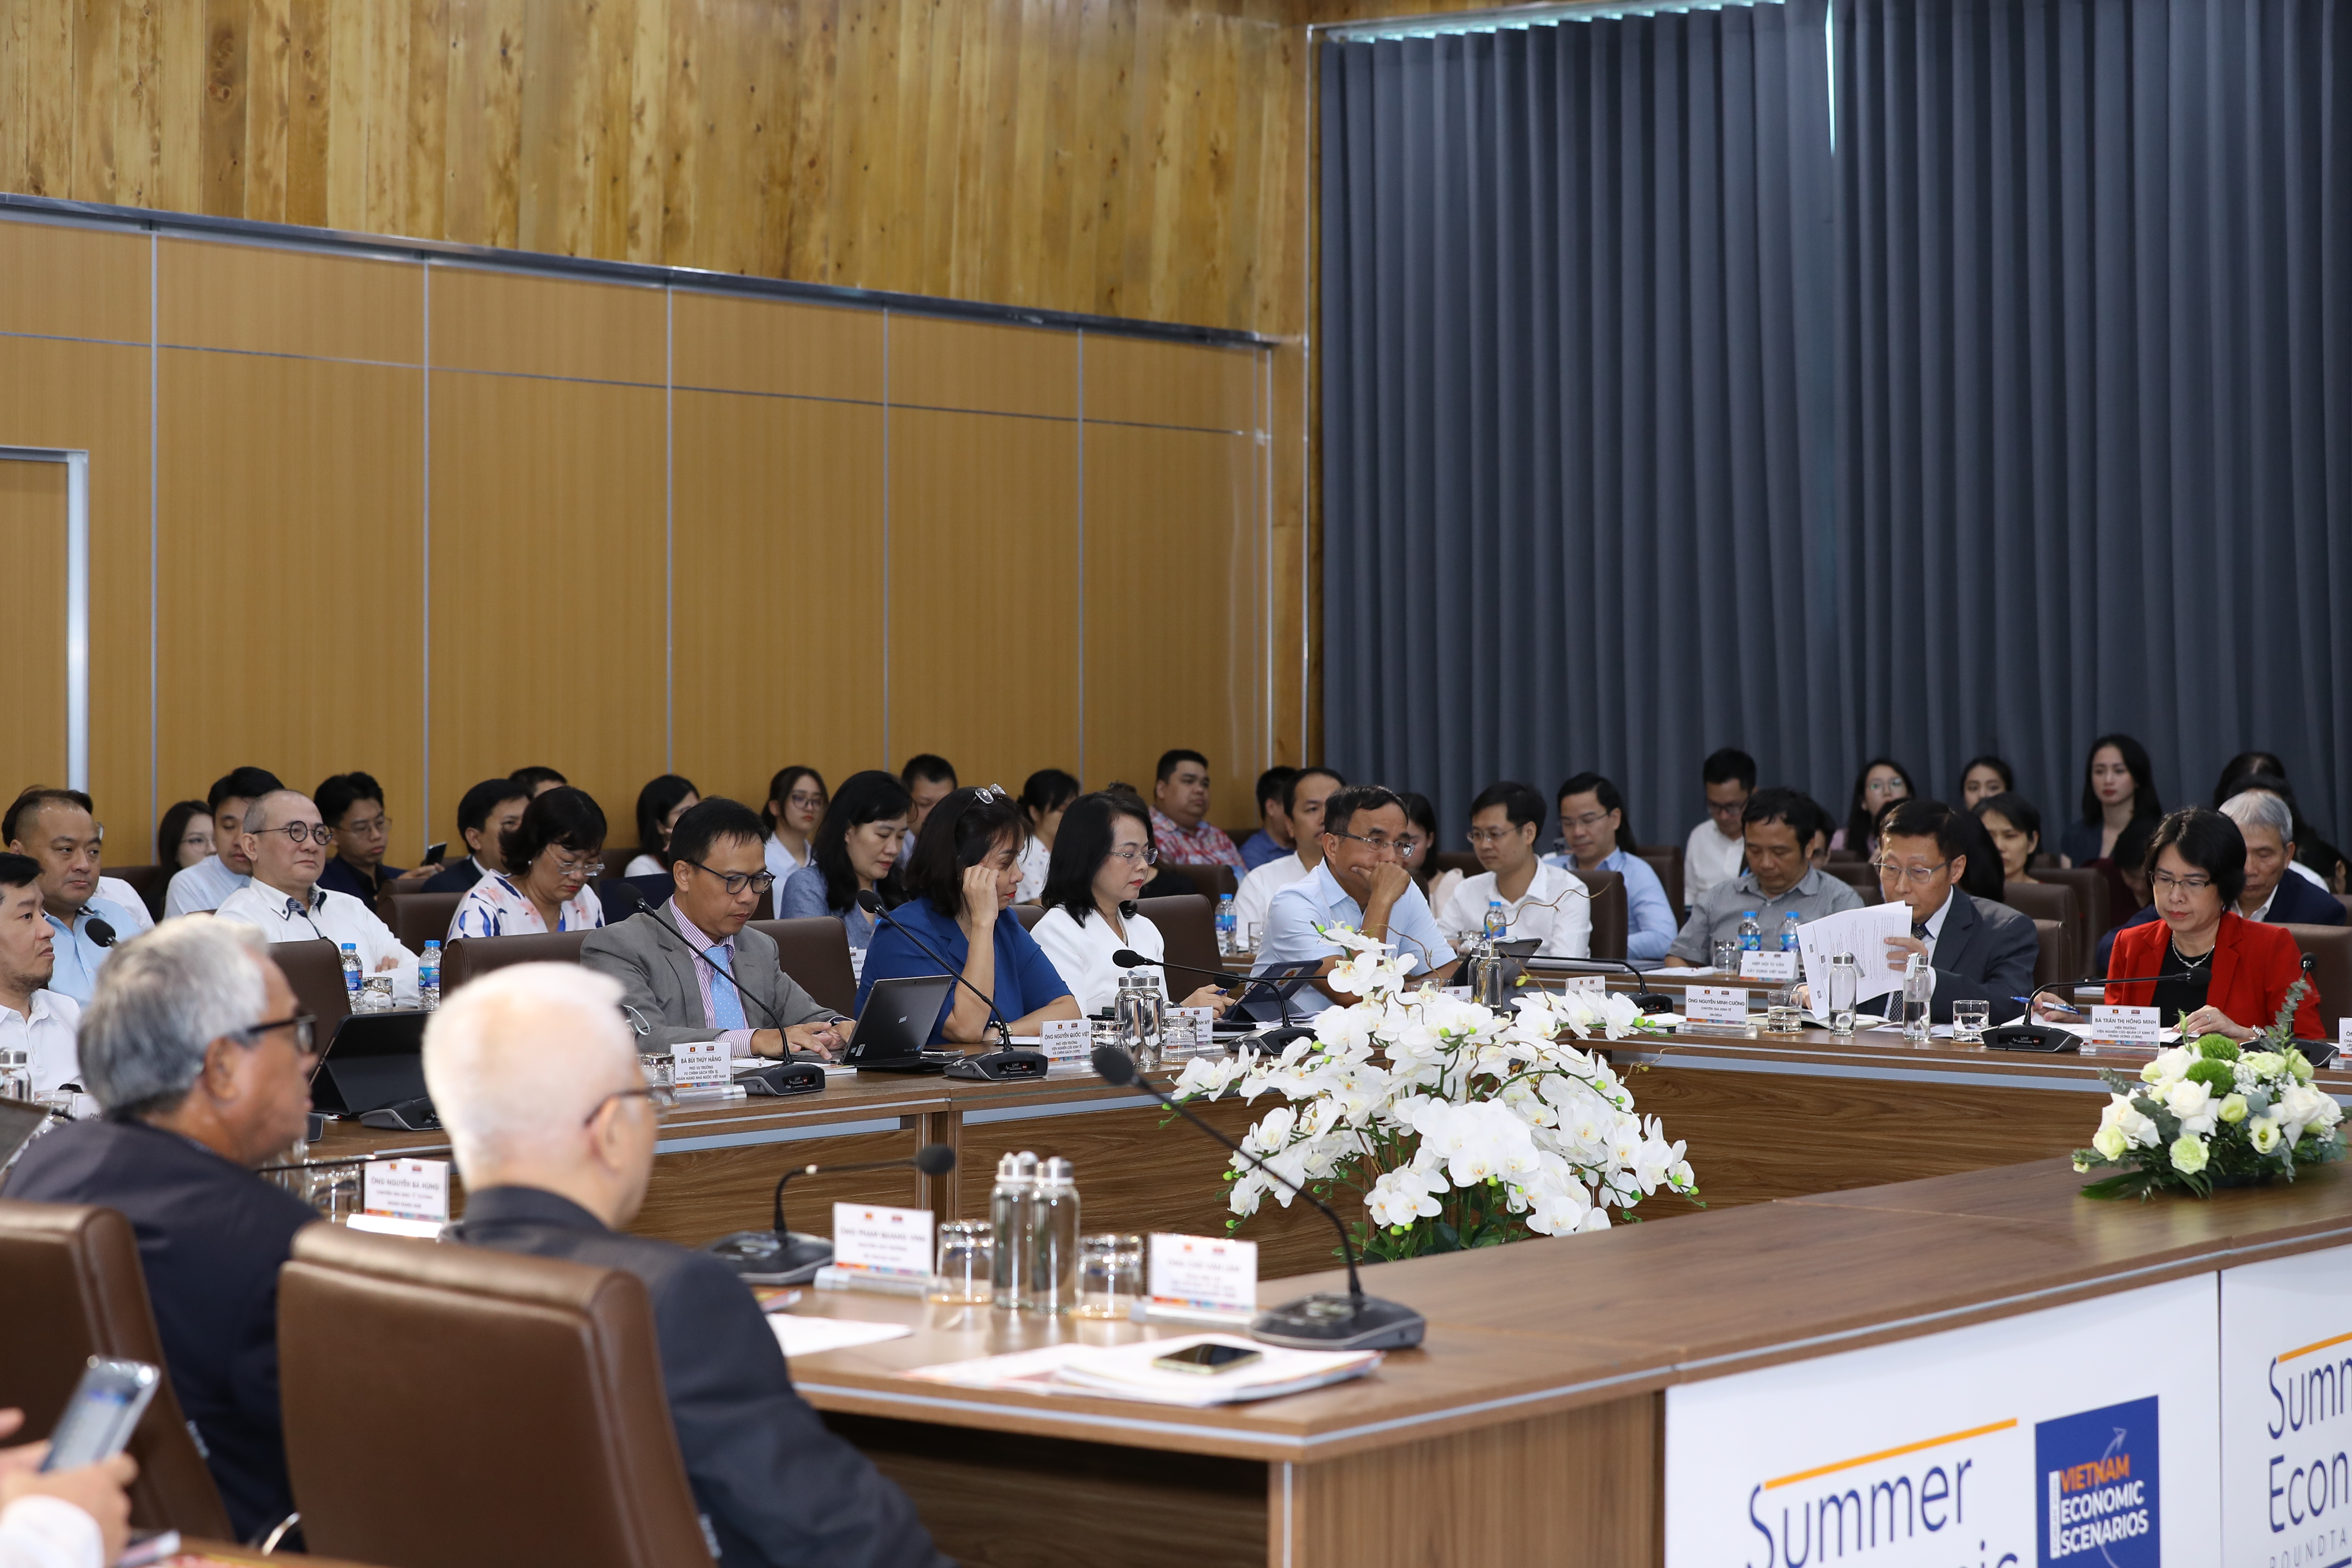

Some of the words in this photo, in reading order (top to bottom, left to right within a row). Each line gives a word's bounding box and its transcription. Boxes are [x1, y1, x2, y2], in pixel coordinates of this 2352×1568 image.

[2059, 1453, 2130, 1493] VIETNAM
[2268, 1451, 2352, 1533] Econ
[1745, 1458, 1972, 1568] Summer
[2061, 1479, 2145, 1525] ECONOMIC
[2060, 1509, 2150, 1556] SCENARIOS
